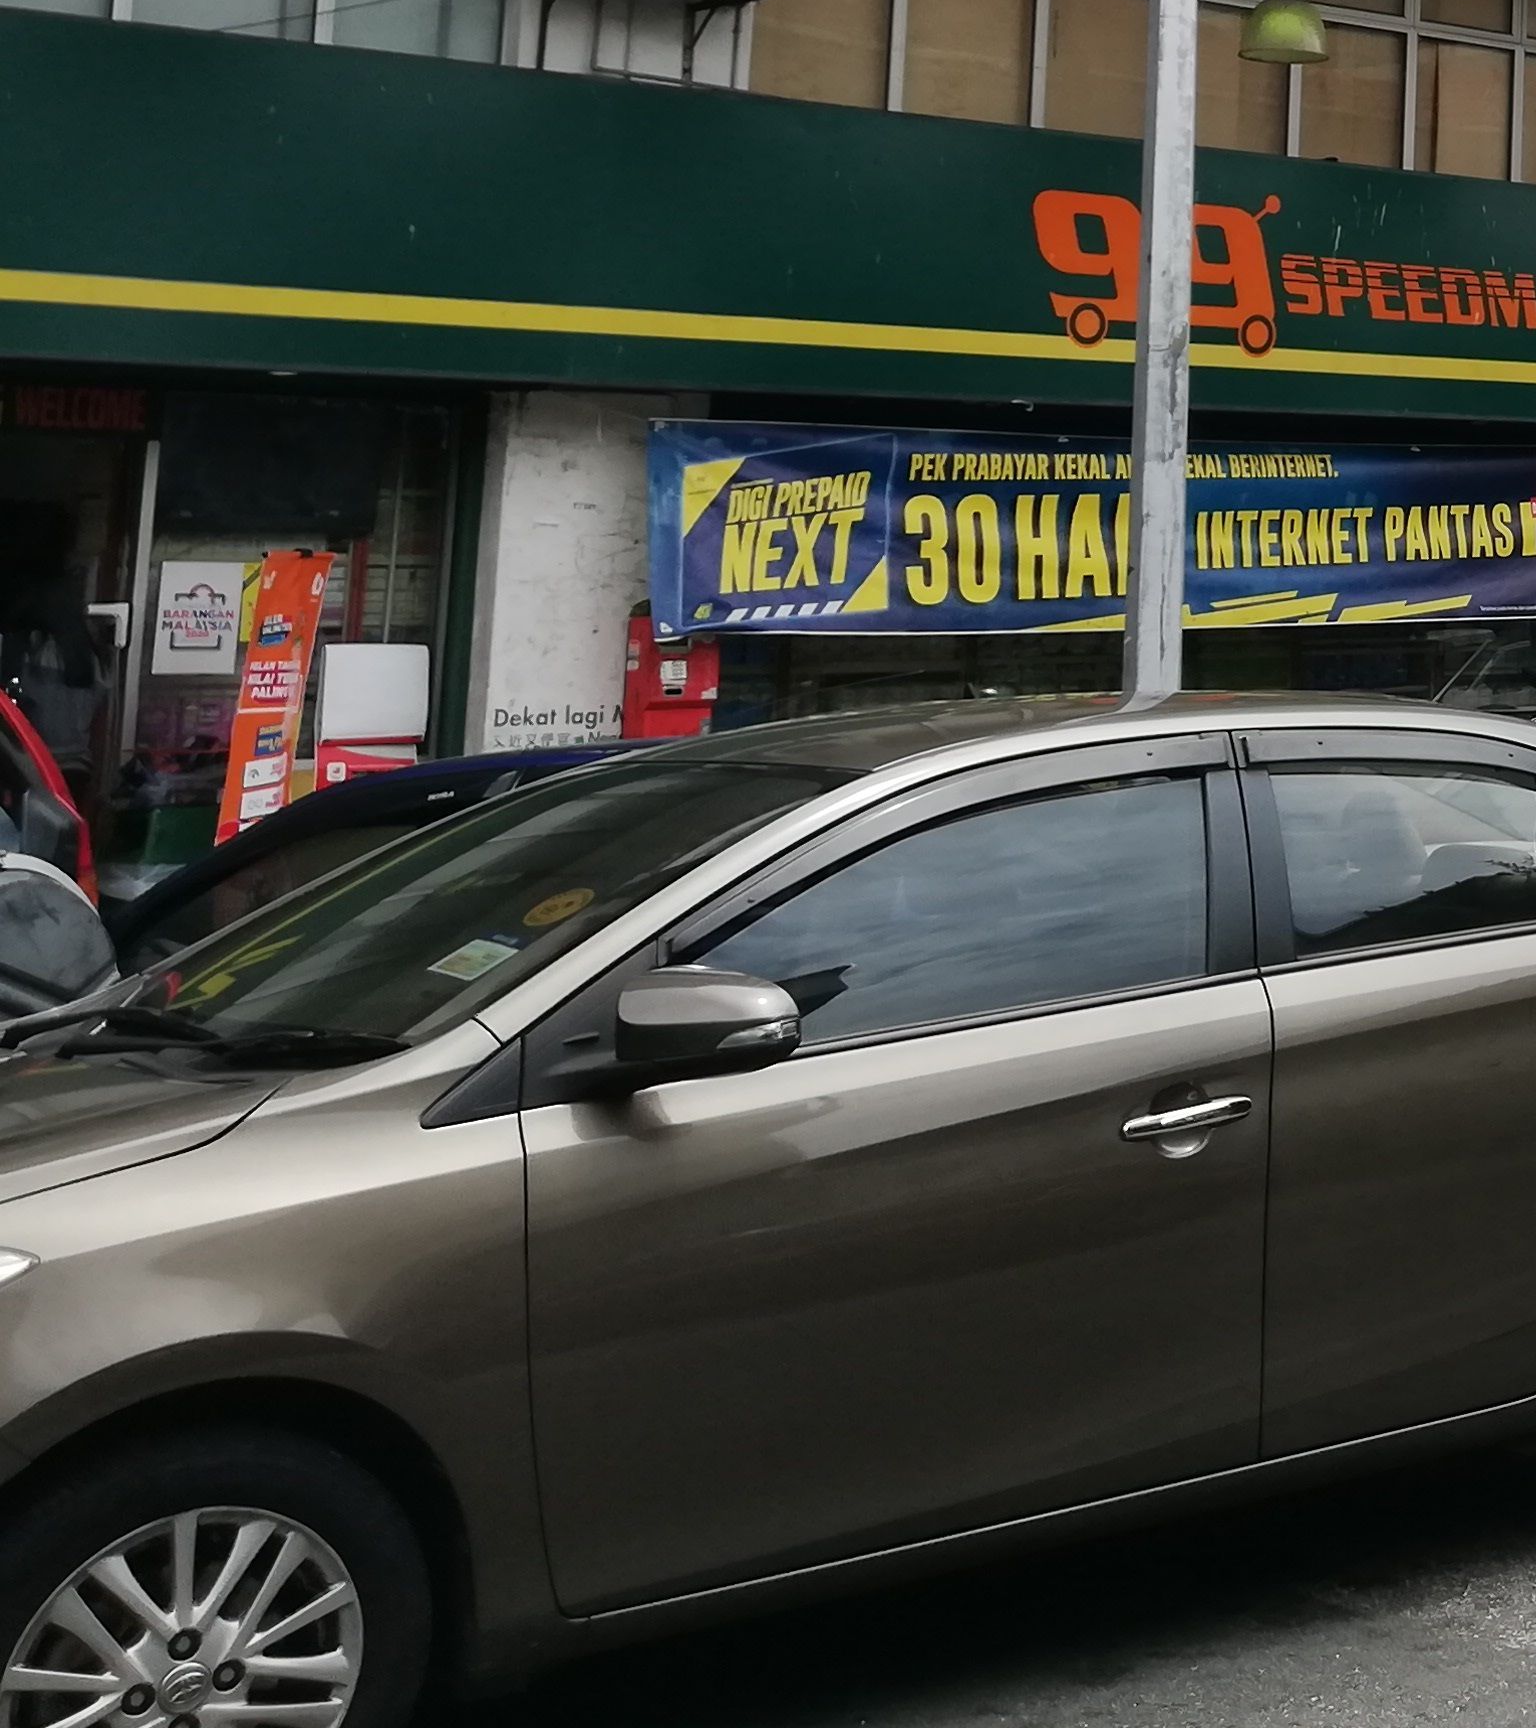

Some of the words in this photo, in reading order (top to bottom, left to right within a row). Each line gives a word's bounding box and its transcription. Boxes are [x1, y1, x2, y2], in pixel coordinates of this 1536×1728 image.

[1033, 190, 1280, 358] 99
[909, 453, 947, 482] PEK
[952, 453, 1049, 481] PRABAYAR
[1054, 453, 1111, 480] KEKAL
[1178, 454, 1227, 479] EKAL
[726, 485, 774, 524] DIGI
[773, 471, 872, 517] PREPAID
[720, 508, 866, 594] NEXT
[904, 494, 1000, 606] 30
[1196, 507, 1374, 570] INTERNET
[1384, 502, 1512, 563] PANTAS
[163, 609, 235, 619] BARANGAN
[494, 705, 557, 727] Dekat
[565, 705, 604, 729] lagi
